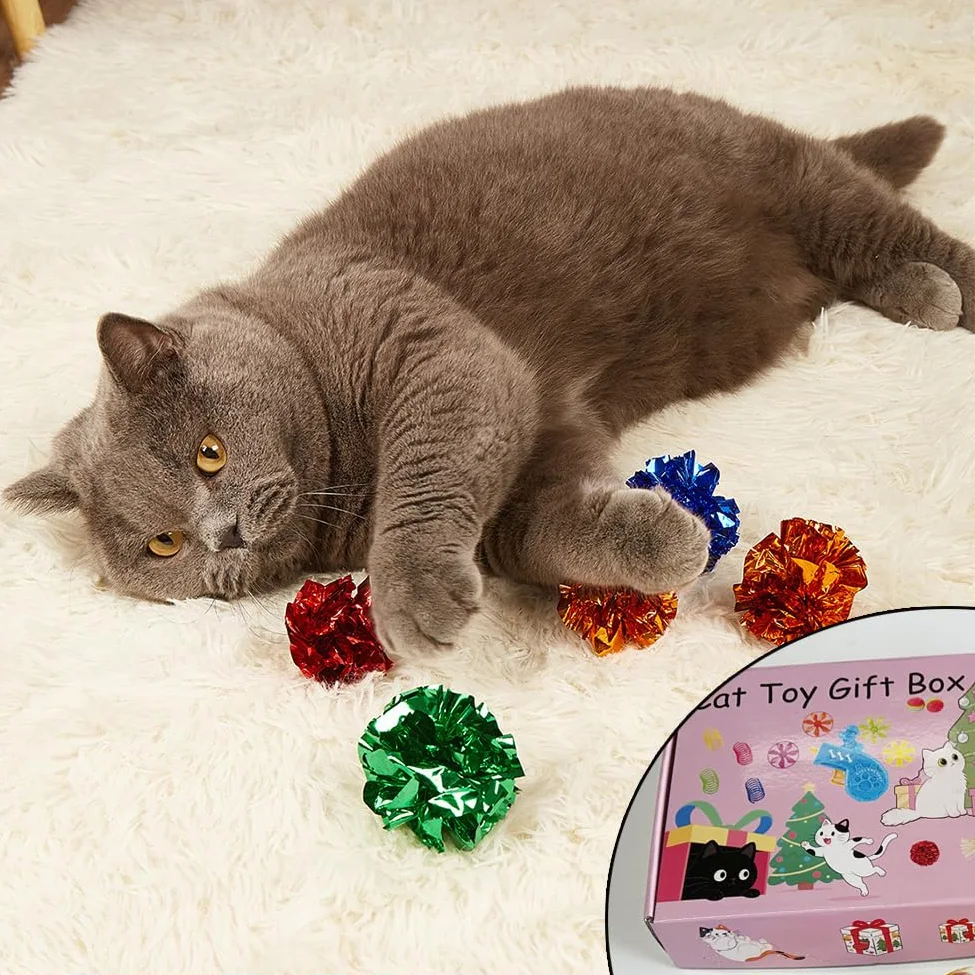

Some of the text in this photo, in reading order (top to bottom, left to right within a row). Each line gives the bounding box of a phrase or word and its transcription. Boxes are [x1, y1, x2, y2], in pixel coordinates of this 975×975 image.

[760, 682, 818, 709] Toy
[829, 674, 895, 701] Gift
[908, 671, 966, 695] Box
